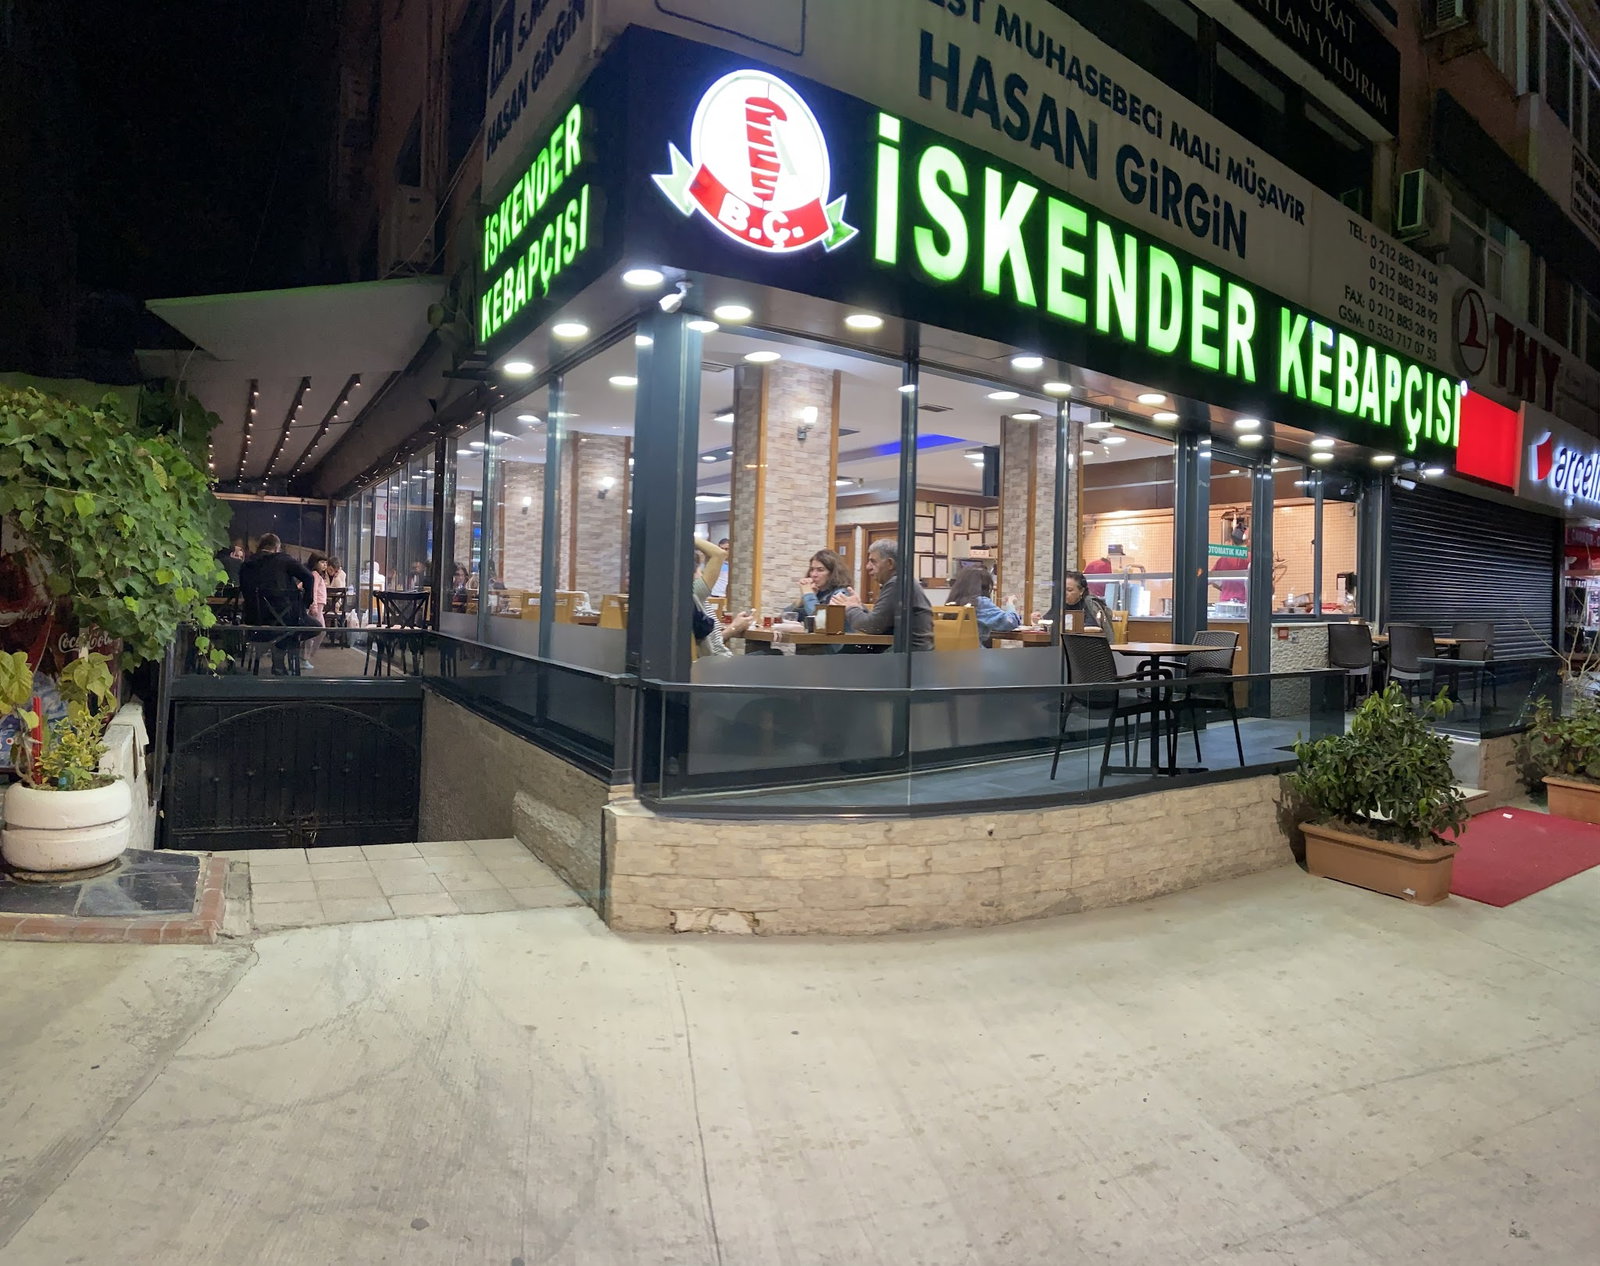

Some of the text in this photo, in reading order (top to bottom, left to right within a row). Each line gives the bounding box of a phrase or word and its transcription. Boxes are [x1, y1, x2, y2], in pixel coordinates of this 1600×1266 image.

[929, 0, 985, 24] ST
[919, 29, 1098, 180] HASAN
[1317, 28, 1387, 114] YILDIRIM
[487, 69, 528, 161] HASAN
[481, 184, 589, 343] KEBAPÇISI
[1348, 219, 1367, 243] TEL:
[1371, 235, 1377, 248] 0
[1379, 240, 1396, 261] 212
[1370, 256, 1376, 270] 0
[1378, 261, 1395, 281] 212
[1398, 272, 1414, 291] 883
[1338, 305, 1437, 361] GSM: 0 533 717 07 53
[1344, 285, 1437, 344] FAX: 0 212 883 28 93
[1369, 277, 1438, 325] 0 212 883 28 92
[1279, 306, 1461, 452] KEBAPÇISI
[1493, 312, 1561, 411] THY
